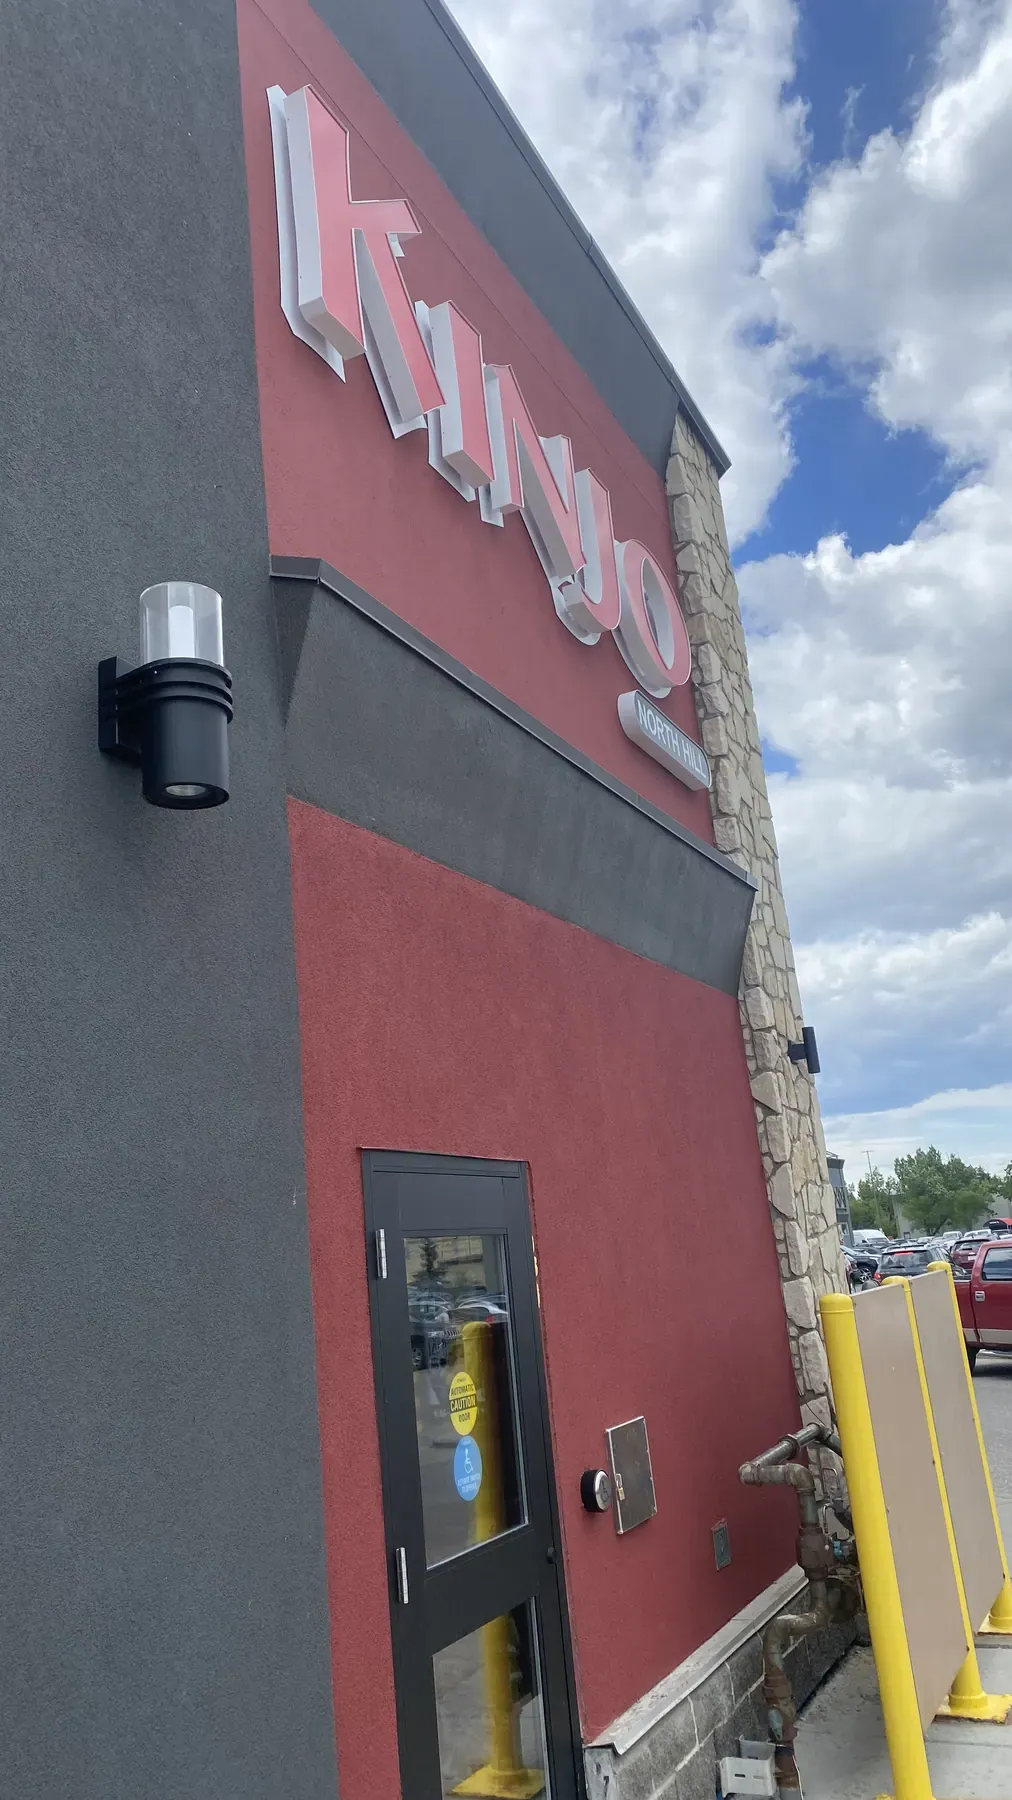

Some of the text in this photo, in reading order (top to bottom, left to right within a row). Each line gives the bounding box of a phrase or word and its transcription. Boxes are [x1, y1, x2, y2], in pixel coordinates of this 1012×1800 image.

[268, 84, 691, 697] KINJO
[637, 699, 707, 778] NORTH HILL
[451, 1384, 474, 1396] AUTOMATIC
[450, 1395, 476, 1412] CAUTION
[458, 1412, 471, 1423] DOOR
